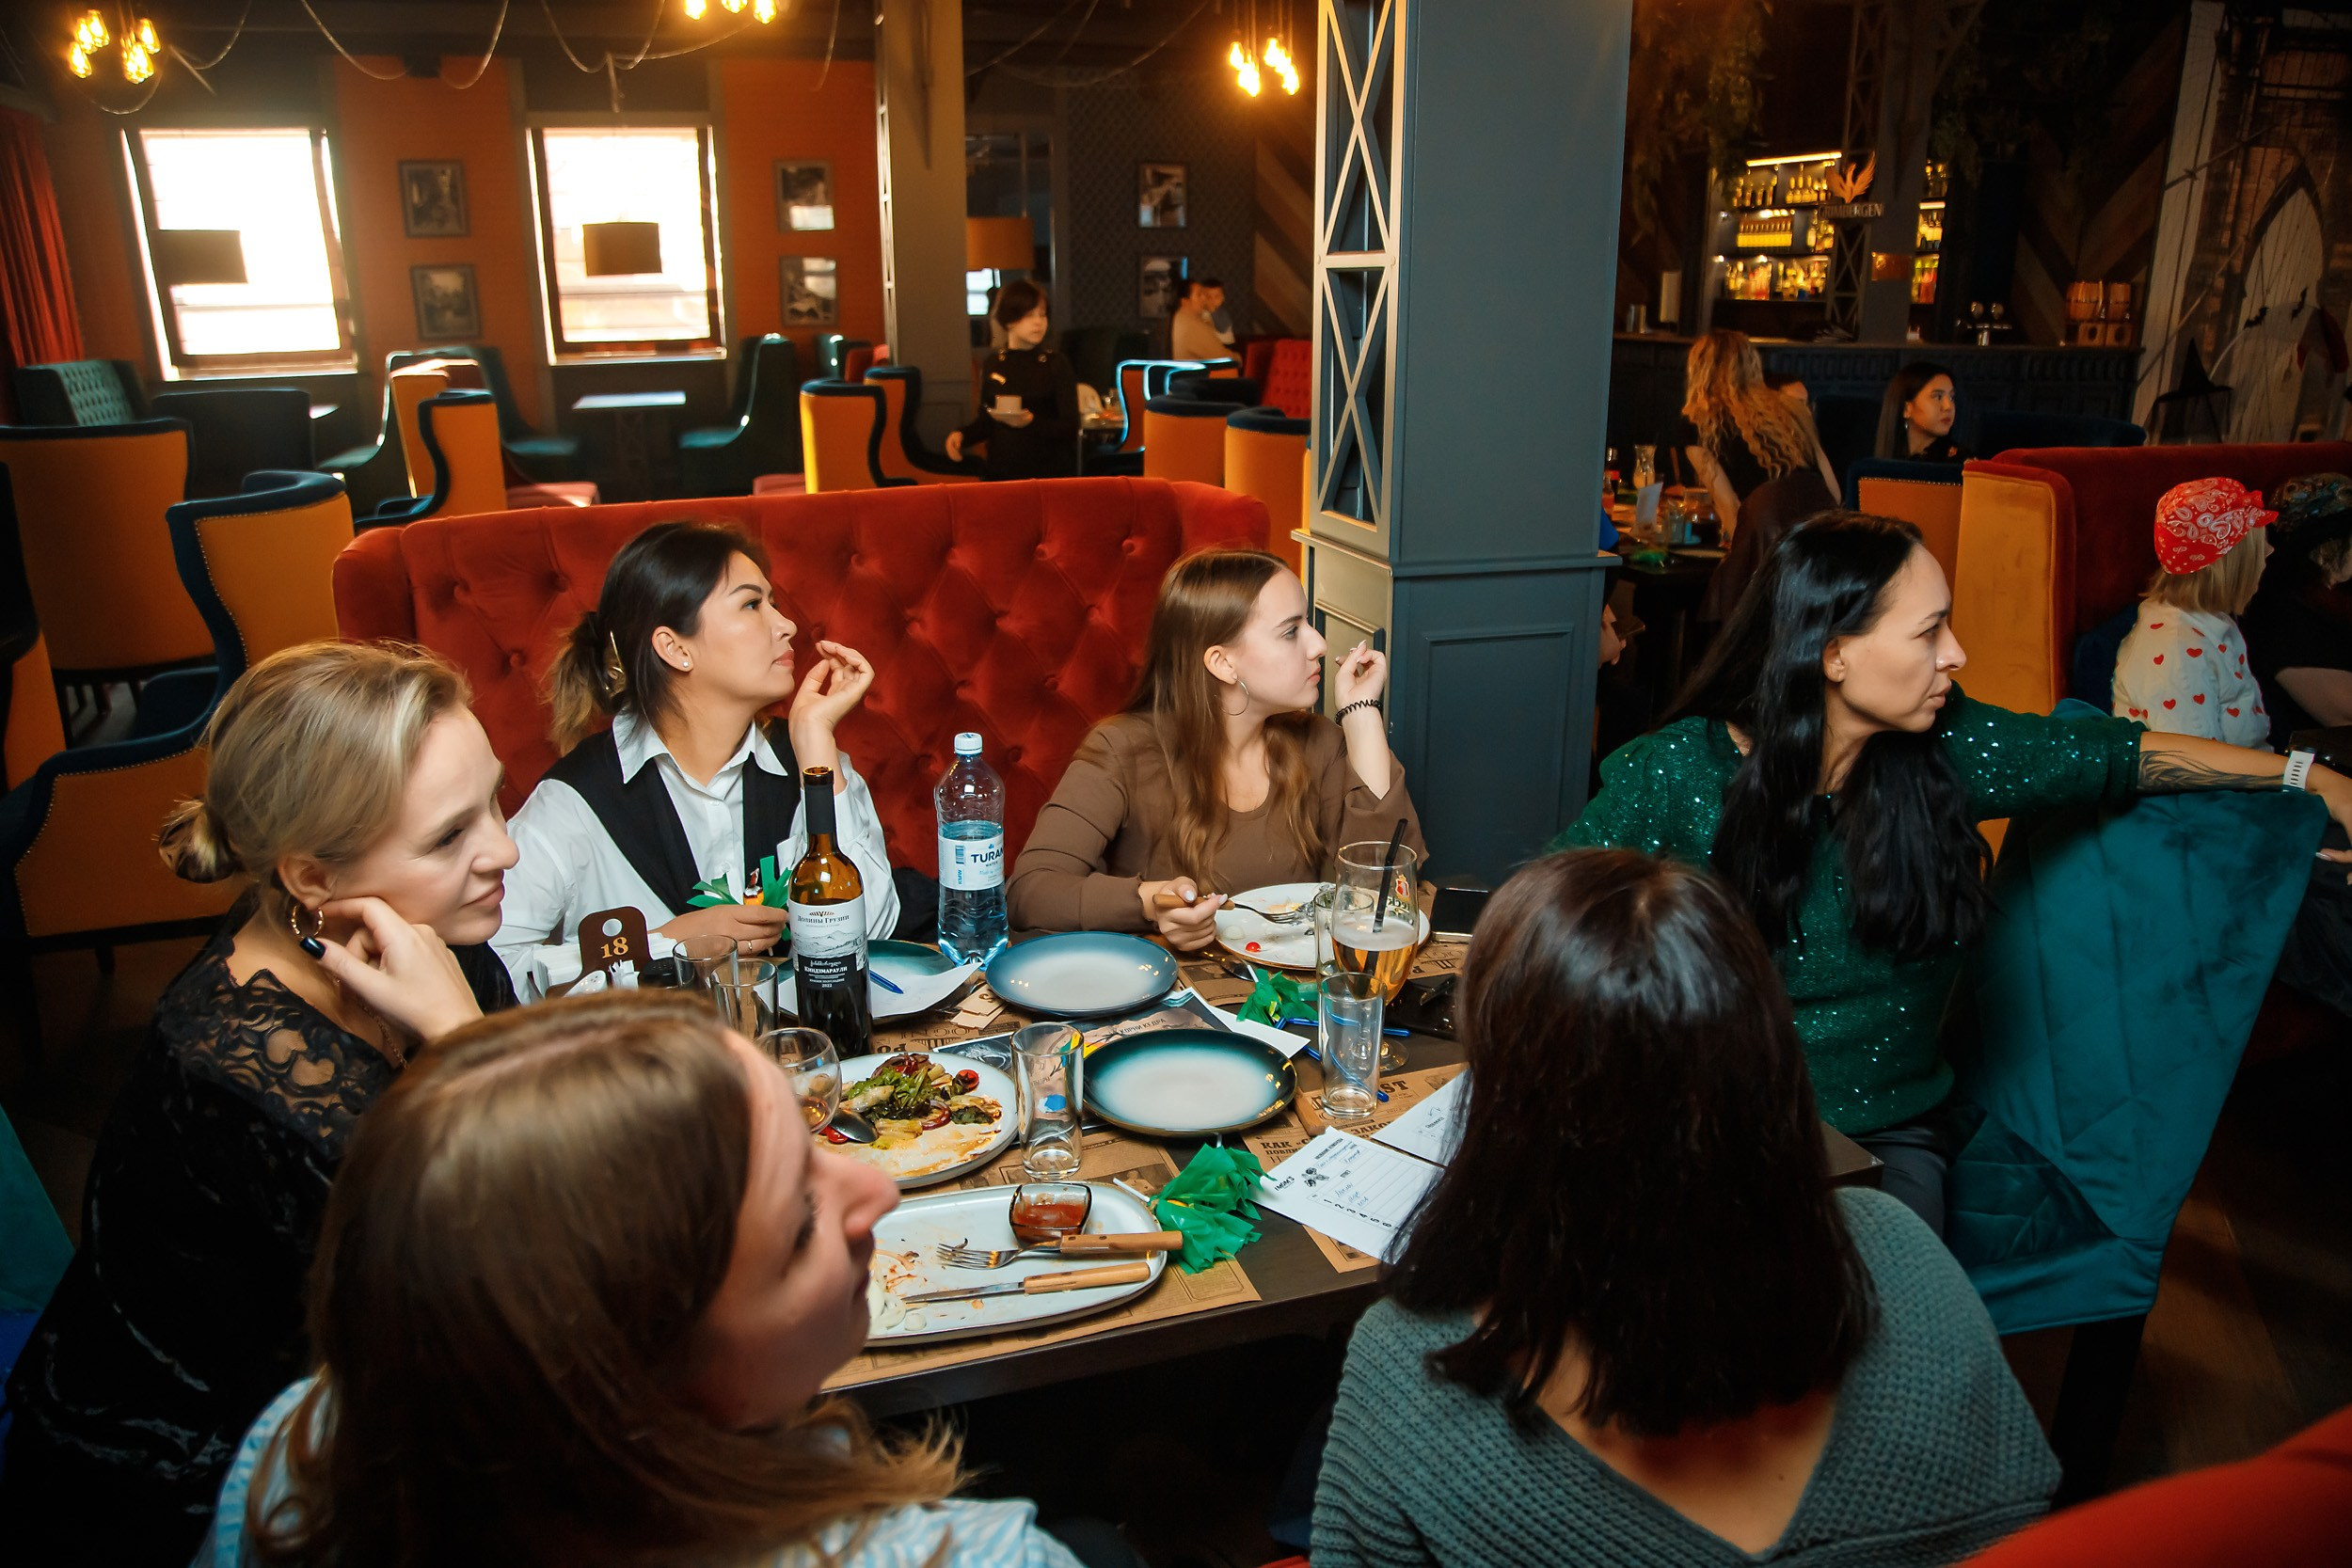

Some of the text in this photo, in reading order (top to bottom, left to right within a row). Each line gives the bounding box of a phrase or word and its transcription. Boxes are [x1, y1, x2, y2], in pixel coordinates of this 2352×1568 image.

[600, 937, 629, 958] 18
[1143, 1017, 1167, 1030] КЕДРА
[1261, 1141, 1293, 1149] КАК
